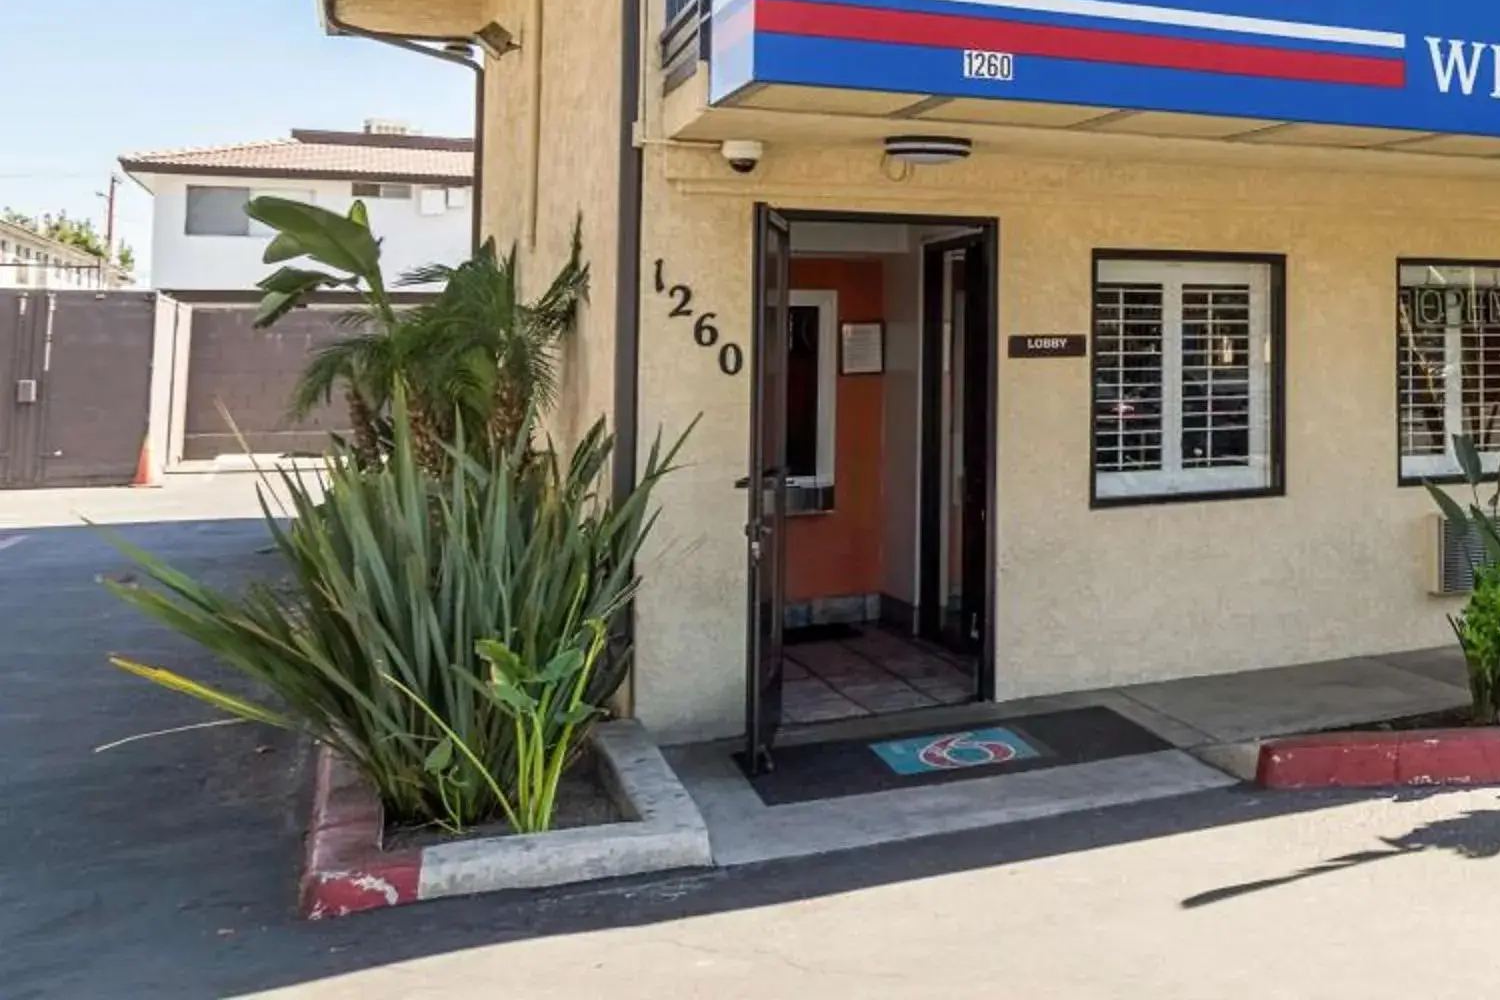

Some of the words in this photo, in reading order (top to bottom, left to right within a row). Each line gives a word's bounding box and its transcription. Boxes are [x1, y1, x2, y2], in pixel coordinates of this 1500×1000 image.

[966, 51, 1011, 78] 1260
[654, 258, 743, 376] 1260
[1027, 338, 1067, 349] LOBBY
